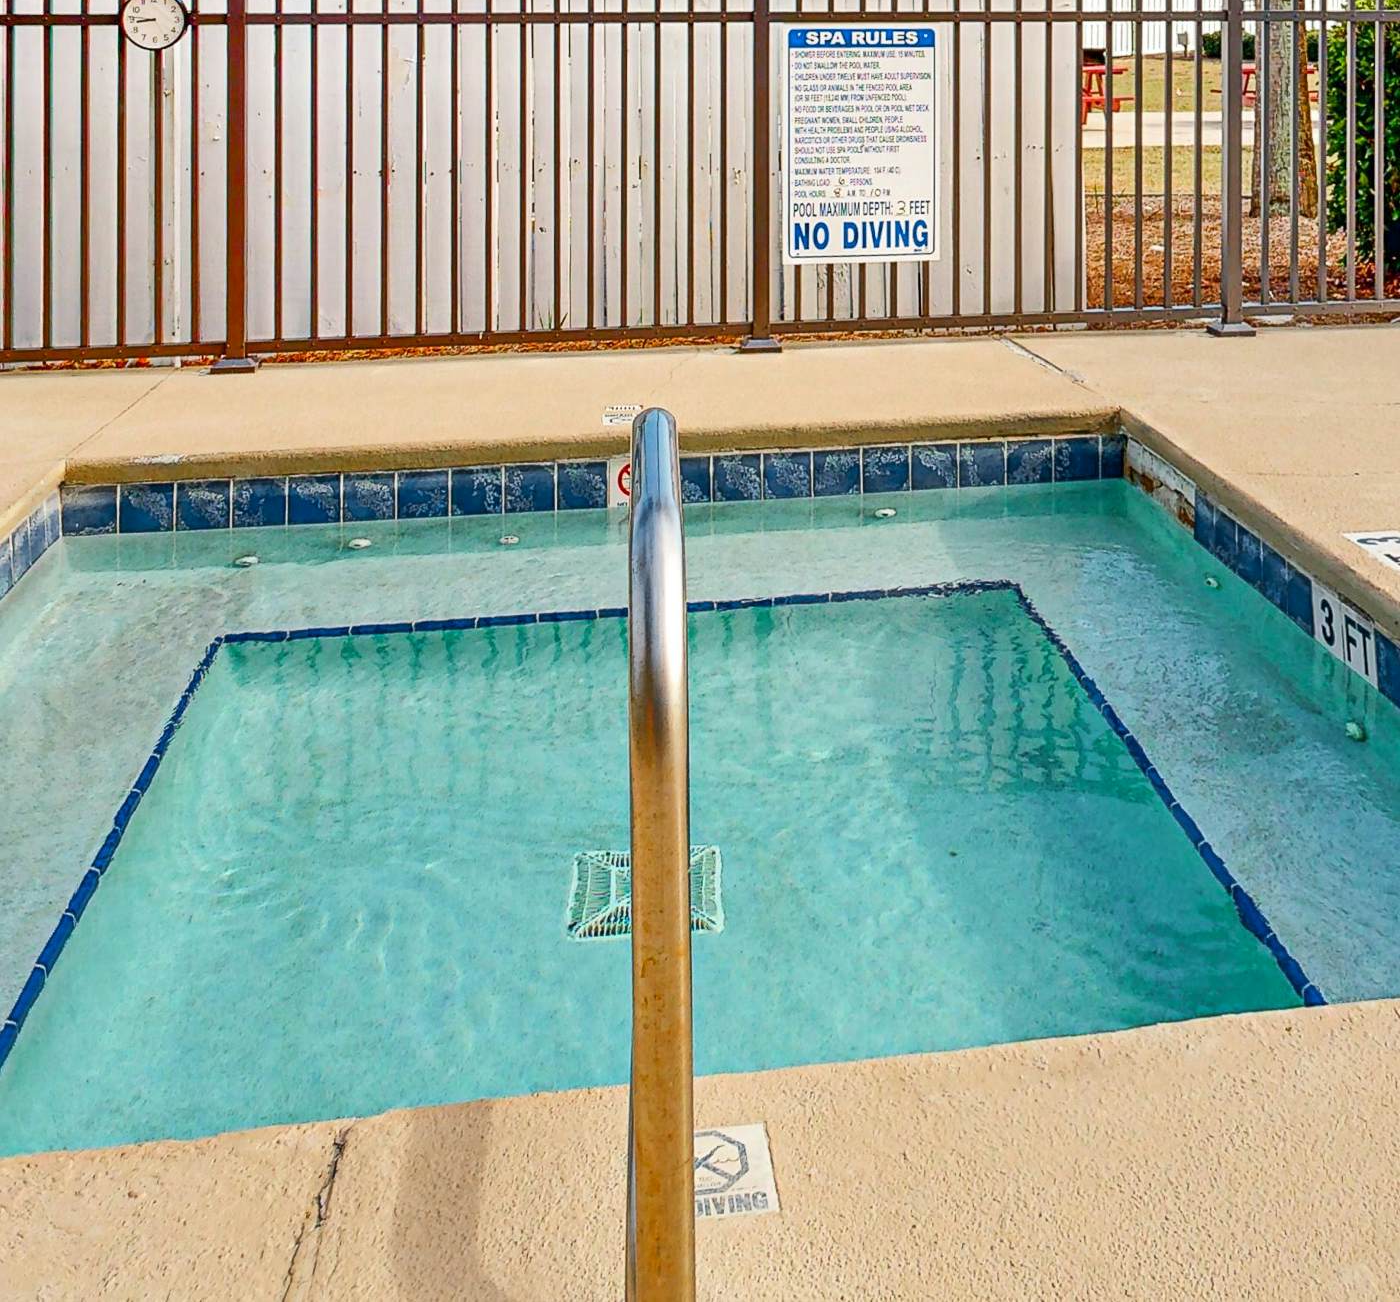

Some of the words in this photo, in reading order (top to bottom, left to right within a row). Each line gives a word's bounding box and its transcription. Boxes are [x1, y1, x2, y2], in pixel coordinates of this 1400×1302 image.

[806, 31, 846, 46] SPA
[852, 31, 918, 46] RULES
[816, 50, 836, 58] BEFORE
[794, 62, 802, 70] DO
[803, 61, 813, 69] NOT
[814, 61, 838, 69] SWALLOW
[838, 61, 848, 69] THE
[849, 61, 862, 69] POOL
[794, 73, 818, 81] CHILDREN
[820, 72, 836, 80] UNDER
[837, 72, 856, 80] TWELVE
[856, 72, 870, 80] MUST
[870, 72, 884, 80] HAVE
[884, 72, 900, 80] ADULT
[794, 84, 803, 92] NO
[803, 84, 818, 92] GLASS
[819, 84, 827, 92] OR
[828, 84, 849, 92] ANIMALS
[856, 84, 865, 92] THE
[866, 84, 884, 92] FENCED
[885, 84, 898, 92] POOL
[899, 83, 912, 91] AREA
[810, 94, 824, 102] FEET
[850, 94, 865, 102] FROM
[865, 94, 890, 102] UNFENCED
[794, 116, 822, 124] PREGNANT
[842, 116, 858, 124] SMALL
[884, 116, 904, 124] PEOPLE
[808, 126, 826, 134] HEALTH
[827, 126, 853, 134] PROBLEMS
[854, 126, 864, 134] AND
[864, 126, 884, 134] PEOPLE
[884, 126, 899, 134] USING
[794, 178, 816, 186] BATHING
[794, 190, 807, 198] POOL
[793, 202, 817, 218] POOL
[820, 202, 860, 216] MAXIMUM
[862, 201, 893, 216] DEPTH:
[897, 200, 906, 215] 3
[910, 200, 930, 215] FEET
[794, 222, 830, 250] NO
[843, 219, 928, 250] DIVING
[1320, 598, 1336, 647] 3
[1344, 614, 1372, 676] FT
